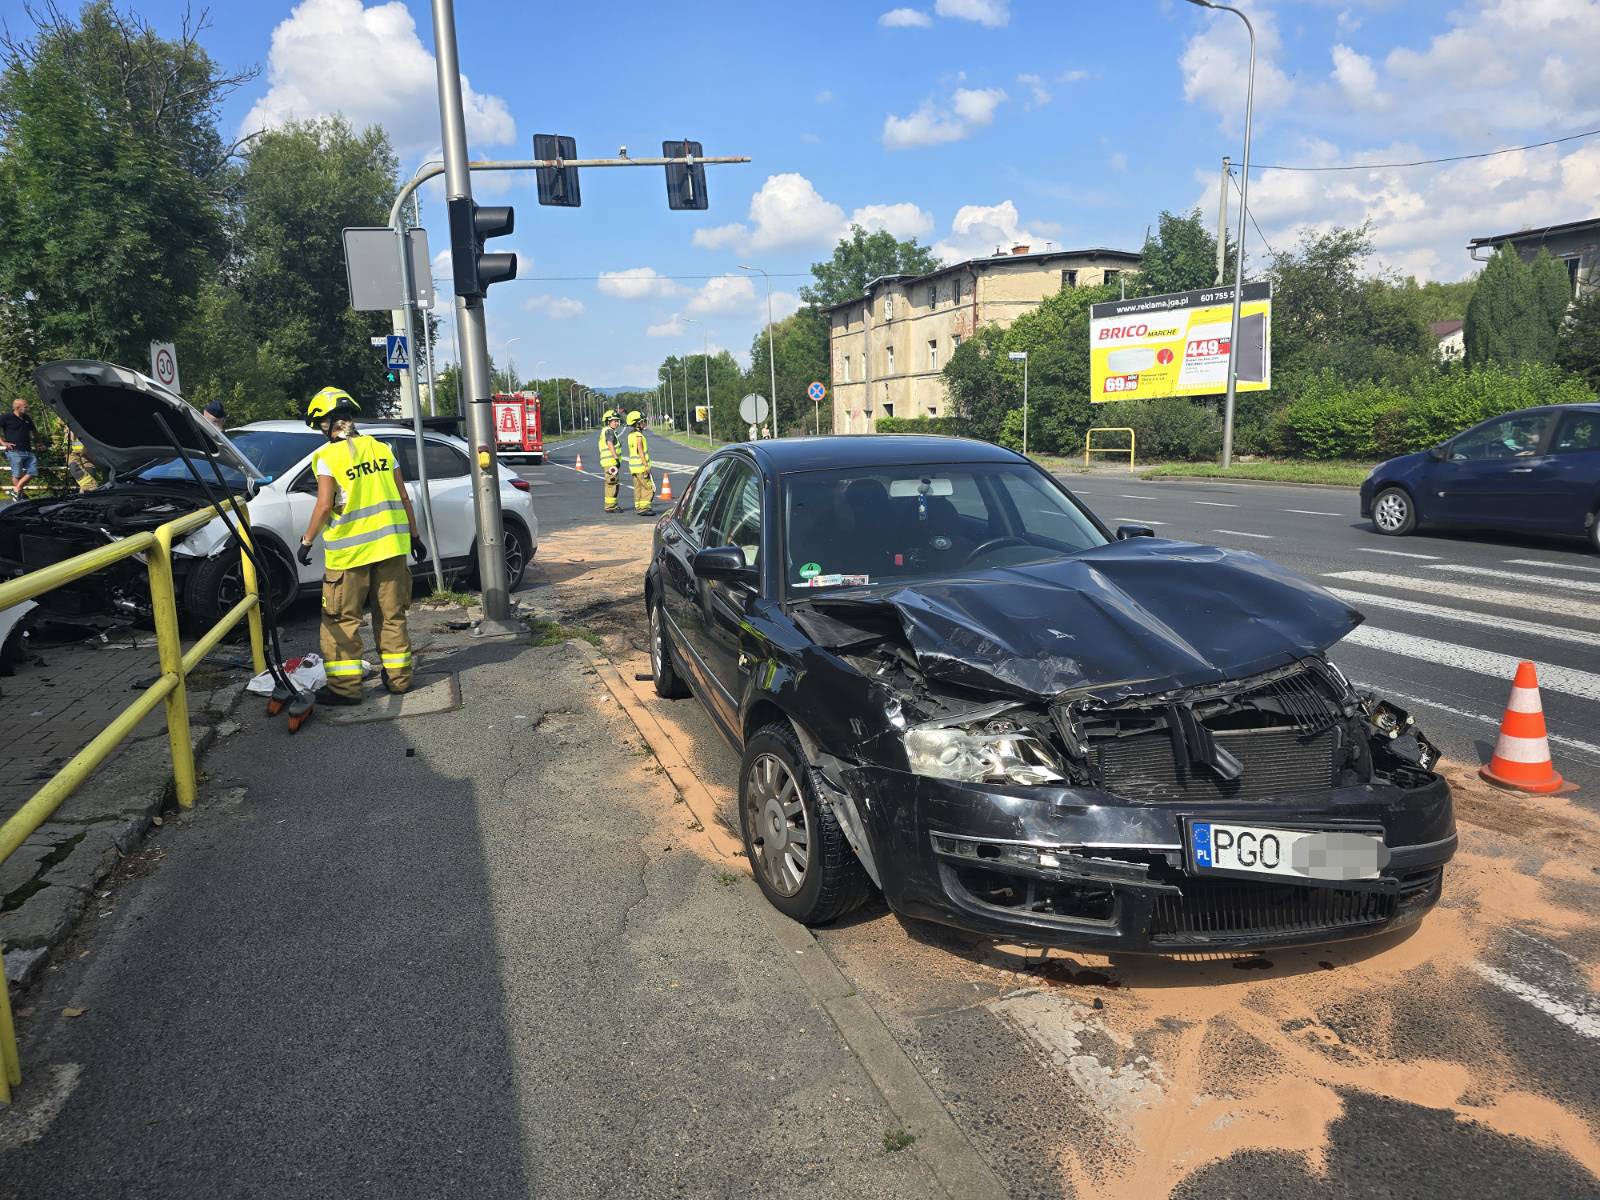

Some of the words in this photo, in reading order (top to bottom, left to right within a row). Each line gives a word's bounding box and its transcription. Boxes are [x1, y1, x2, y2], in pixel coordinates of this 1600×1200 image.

[1200, 293, 1214, 302] 601
[1215, 291, 1228, 300] 755
[1099, 325, 1148, 340] BRICO
[159, 359, 172, 374] 30
[1197, 849, 1210, 861] PL
[1214, 829, 1280, 869] PGO
